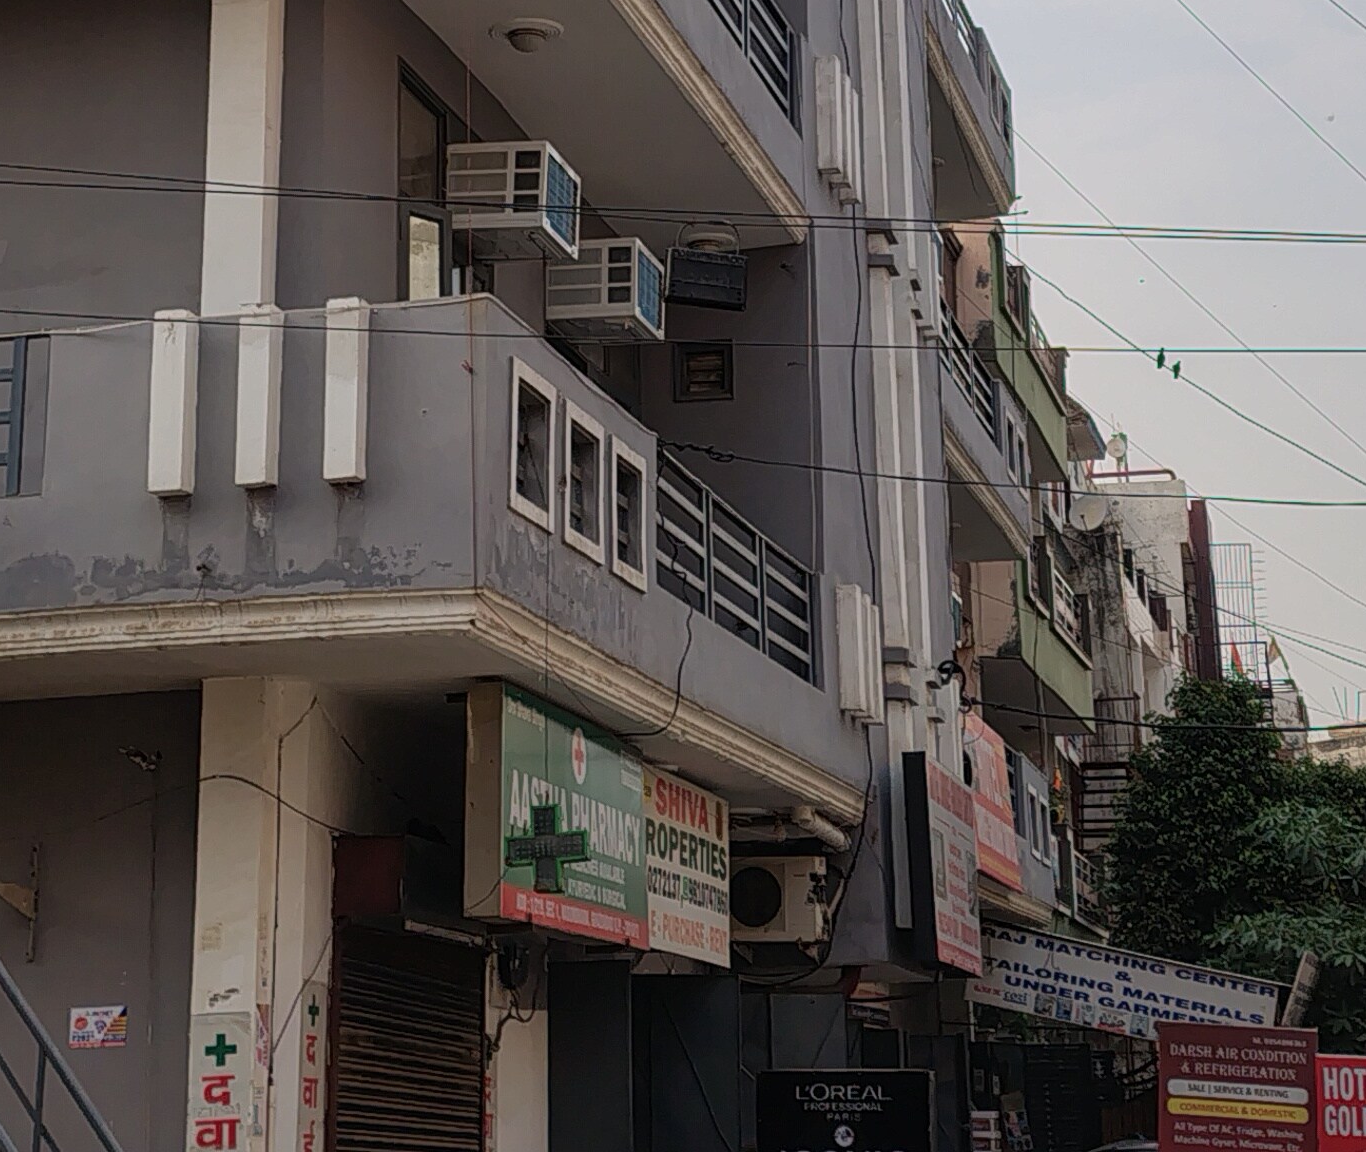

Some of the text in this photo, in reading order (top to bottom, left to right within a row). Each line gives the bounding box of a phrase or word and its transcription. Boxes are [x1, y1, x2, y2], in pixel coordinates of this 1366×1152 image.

[655, 777, 709, 833] SHIVA
[571, 791, 641, 867] PHARMACY
[646, 817, 727, 881] ROPERTIES
[981, 926, 1026, 945] RAJ
[1035, 938, 1166, 975] MATCHING
[1175, 969, 1276, 997] CENTER
[1115, 971, 1132, 982] &
[983, 955, 1113, 994] TAILORING
[1123, 986, 1264, 1024] MATERIALS
[1005, 975, 1089, 1002] UNDER
[1098, 997, 1223, 1024] GARME
[1240, 1047, 1308, 1066] CONDITION
[1195, 1062, 1298, 1081] REFRIGERATION
[1213, 1086, 1243, 1097] SERVICE
[803, 1101, 884, 1112] PROFESSIONAL
[826, 1112, 861, 1122] PARIS
[1187, 1122, 1208, 1134] Type
[1267, 1128, 1305, 1142] Washing
